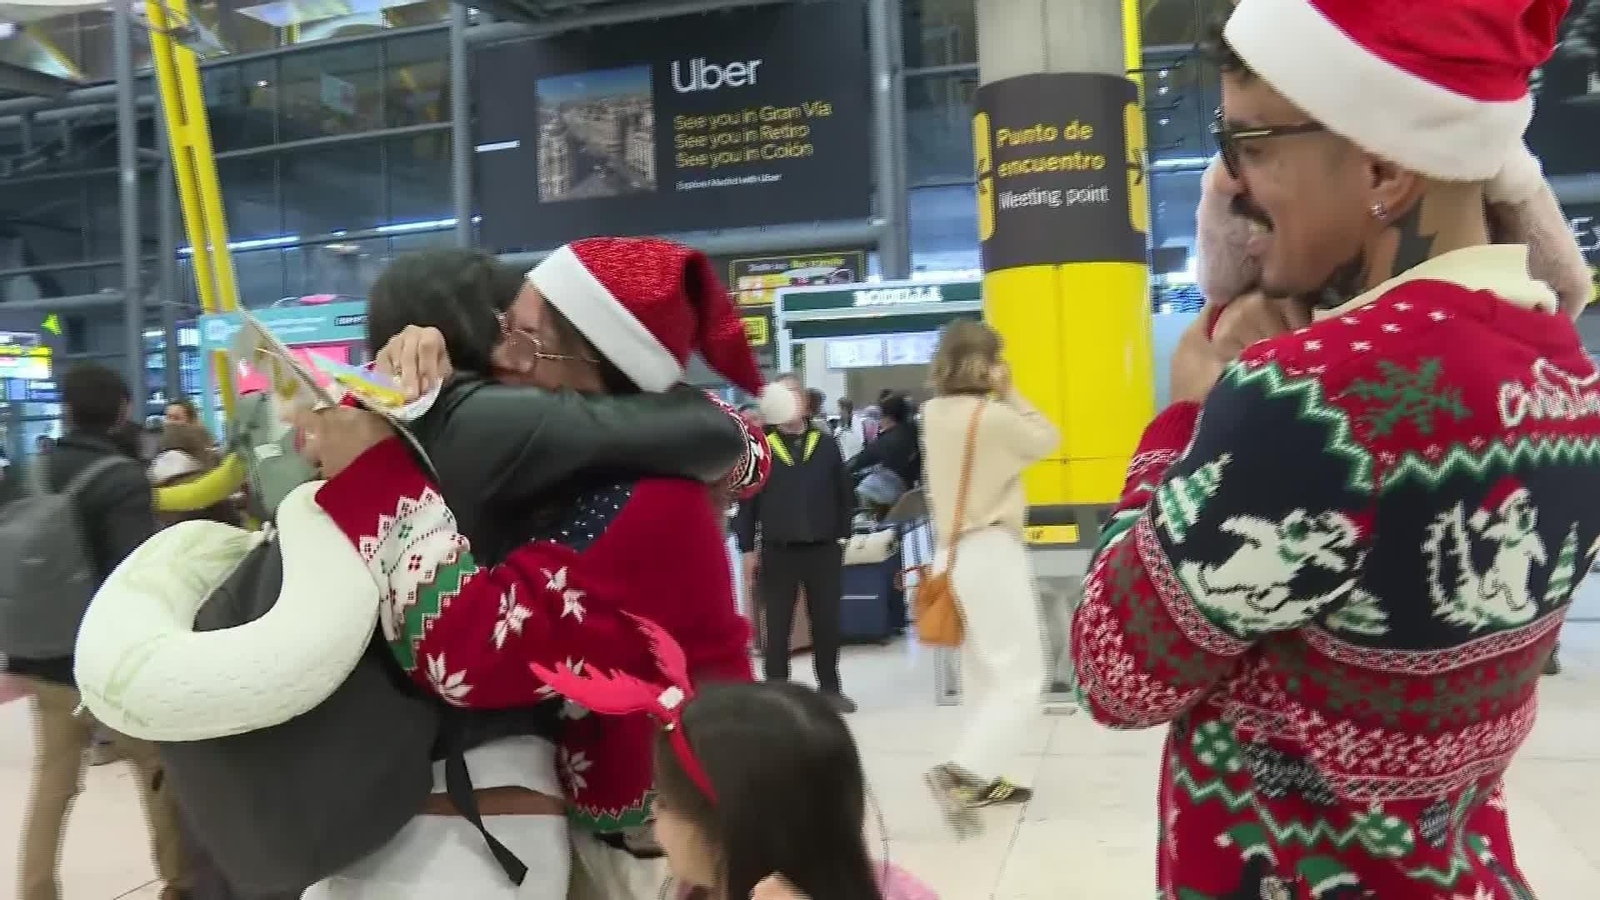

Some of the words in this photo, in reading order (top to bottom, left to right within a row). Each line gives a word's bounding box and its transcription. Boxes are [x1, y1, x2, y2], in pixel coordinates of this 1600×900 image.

[671, 57, 762, 93] Uber
[674, 115, 708, 131] See
[709, 113, 741, 130] you
[742, 108, 758, 123] in
[759, 105, 801, 122] Gran
[674, 133, 708, 149] See
[709, 131, 741, 149] you
[742, 127, 758, 142] in
[759, 124, 810, 140] Retiro
[997, 124, 1058, 148] Punto
[1063, 119, 1093, 141] de
[675, 151, 709, 168] See
[709, 150, 742, 168] you
[743, 146, 759, 161] in
[998, 152, 1106, 178] encuentro
[999, 187, 1062, 209] Meeting
[1066, 184, 1110, 207] point
